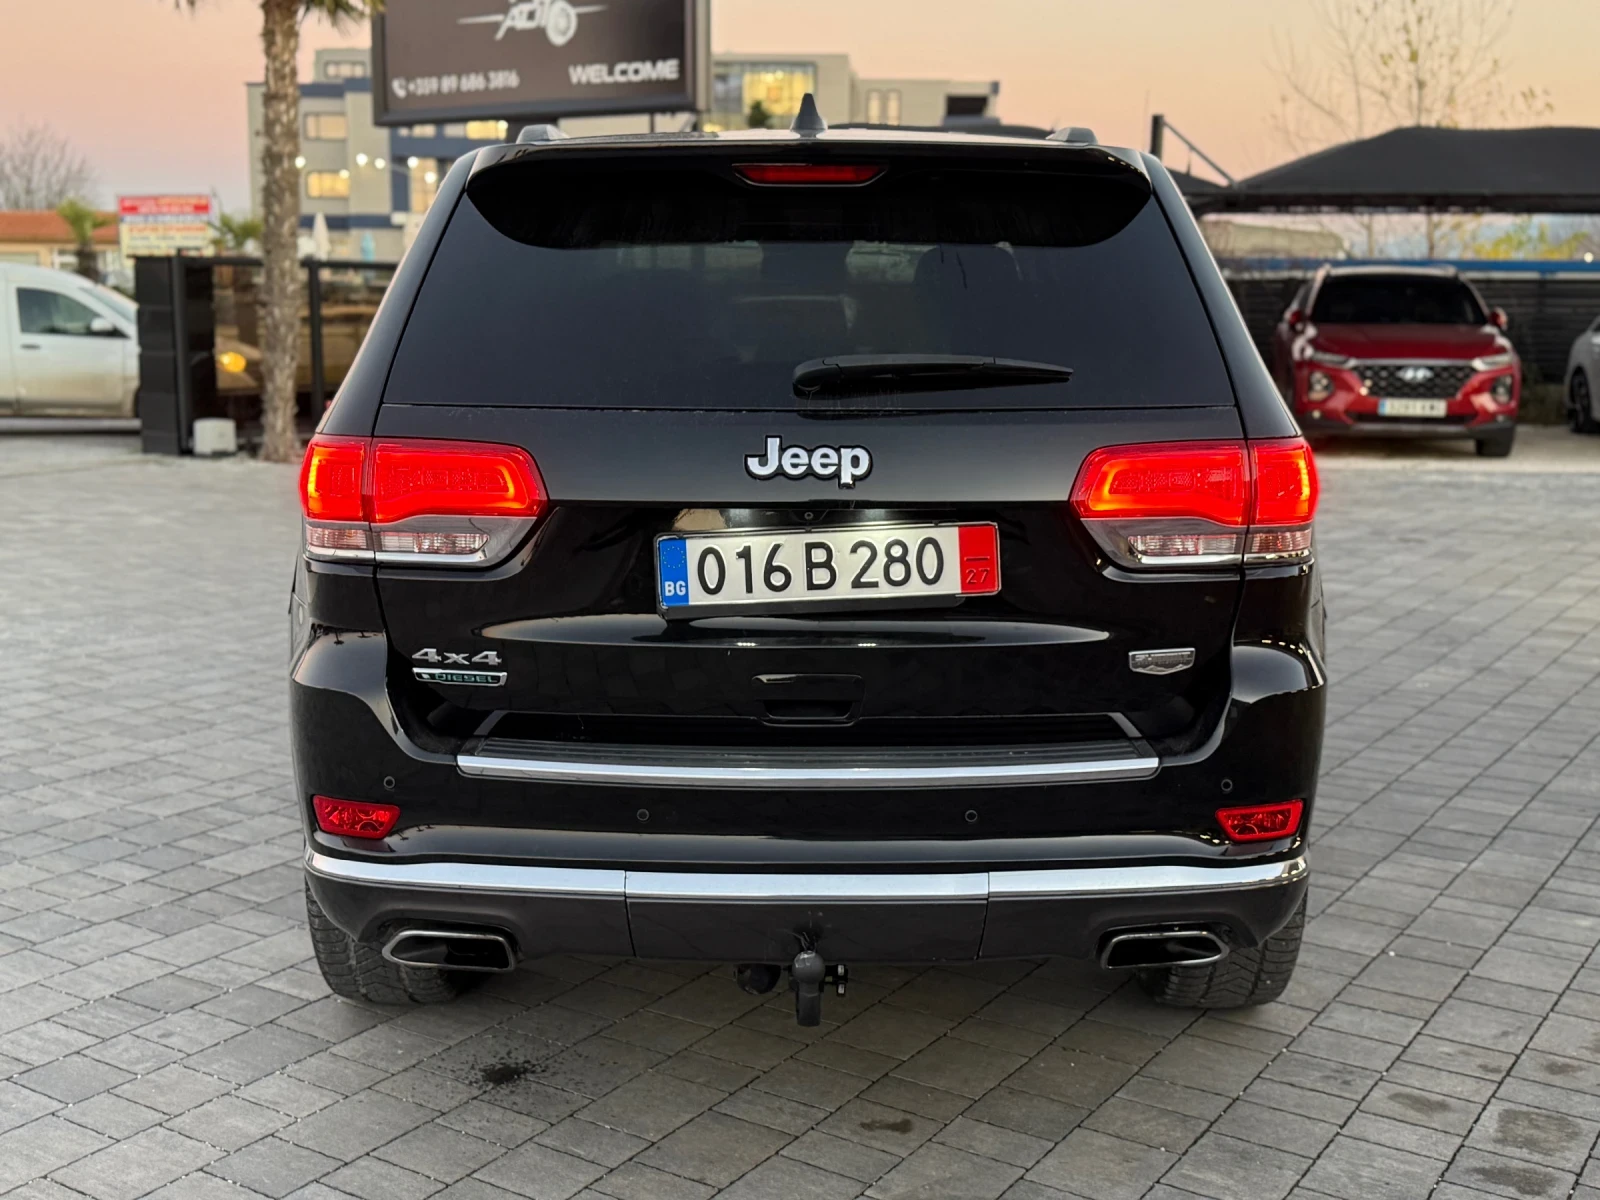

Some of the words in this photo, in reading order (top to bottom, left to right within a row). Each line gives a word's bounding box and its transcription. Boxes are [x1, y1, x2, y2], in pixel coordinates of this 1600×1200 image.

[568, 58, 680, 85] WELCOME
[745, 436, 872, 488] Jeep
[965, 567, 990, 584] 27
[664, 580, 687, 597] BG
[412, 648, 502, 666] 4x4
[435, 673, 498, 683] DIESEL
